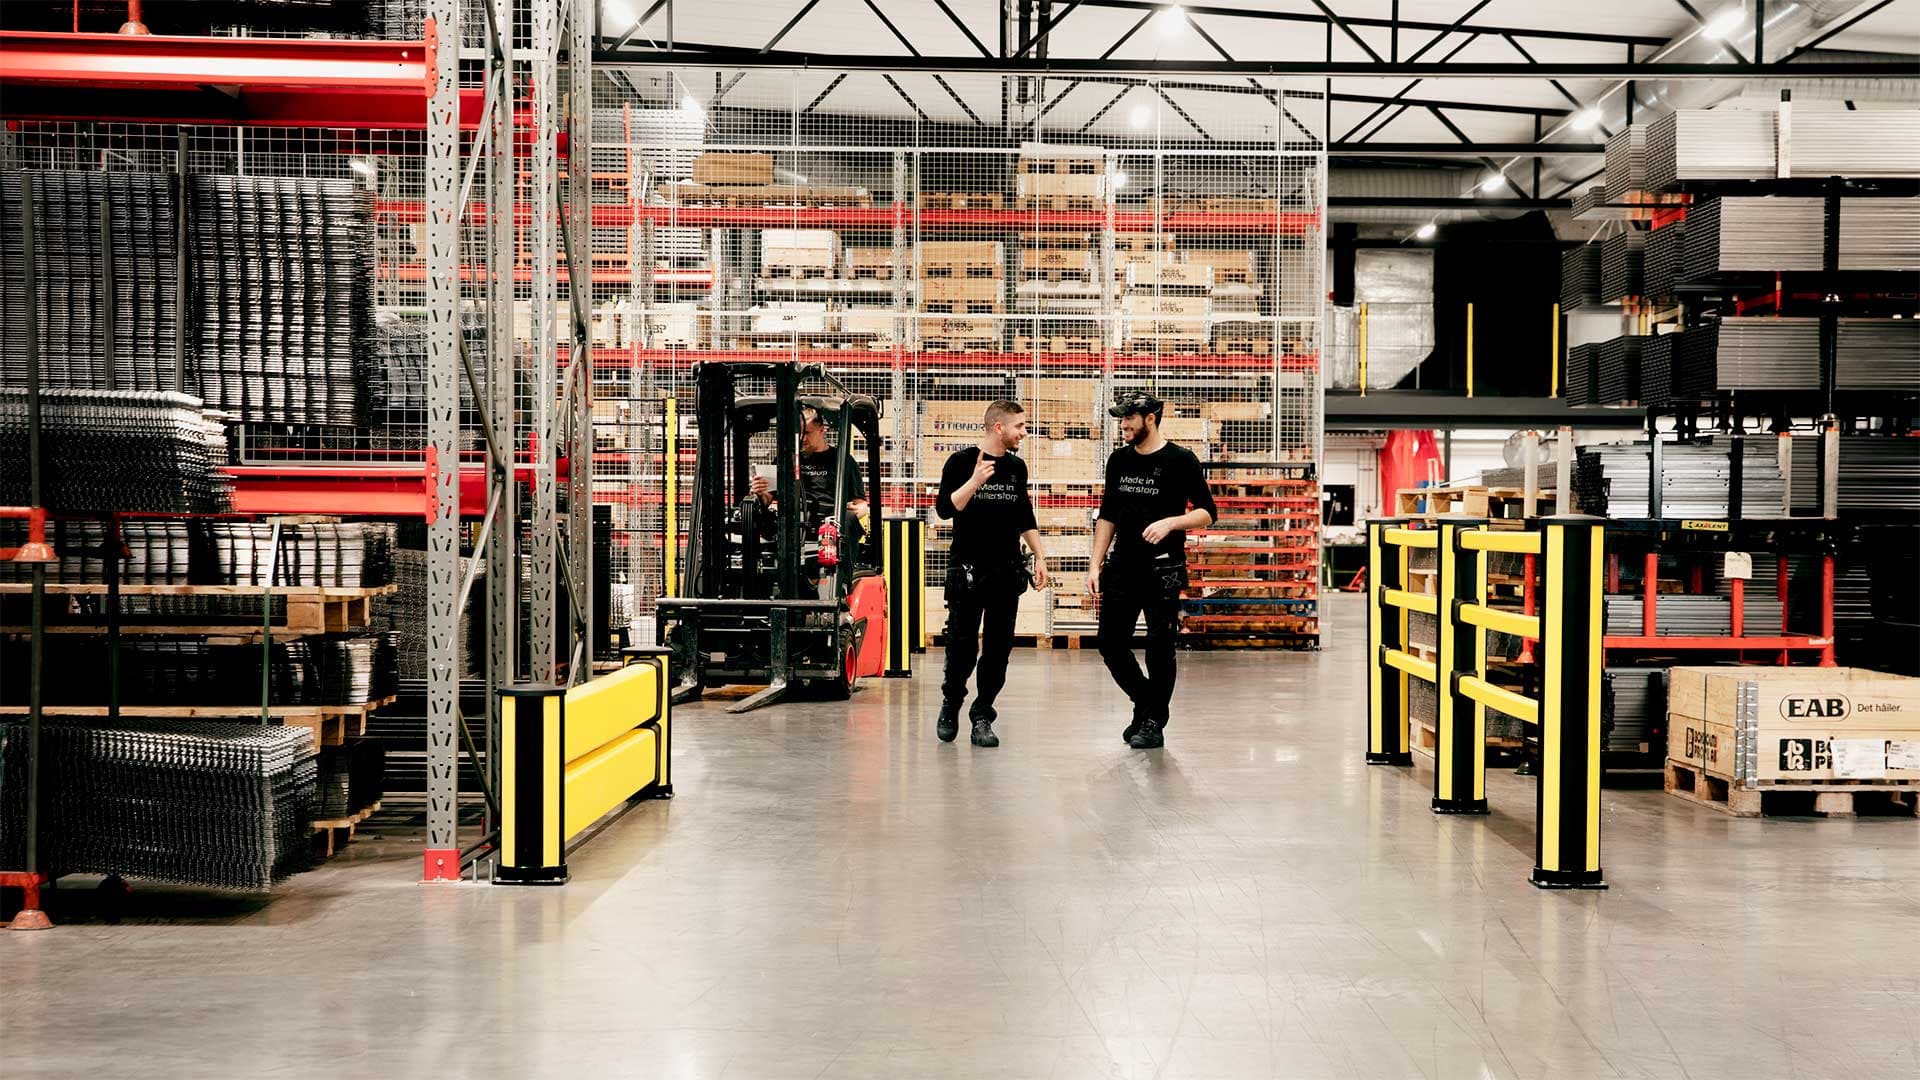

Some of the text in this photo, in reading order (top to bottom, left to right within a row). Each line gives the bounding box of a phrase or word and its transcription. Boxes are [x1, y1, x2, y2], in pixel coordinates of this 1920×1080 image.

[1120, 476, 1154, 485] Made in
[977, 483, 1004, 491] Made
[1787, 699, 1844, 717] EAB
[1857, 704, 1873, 712] Det
